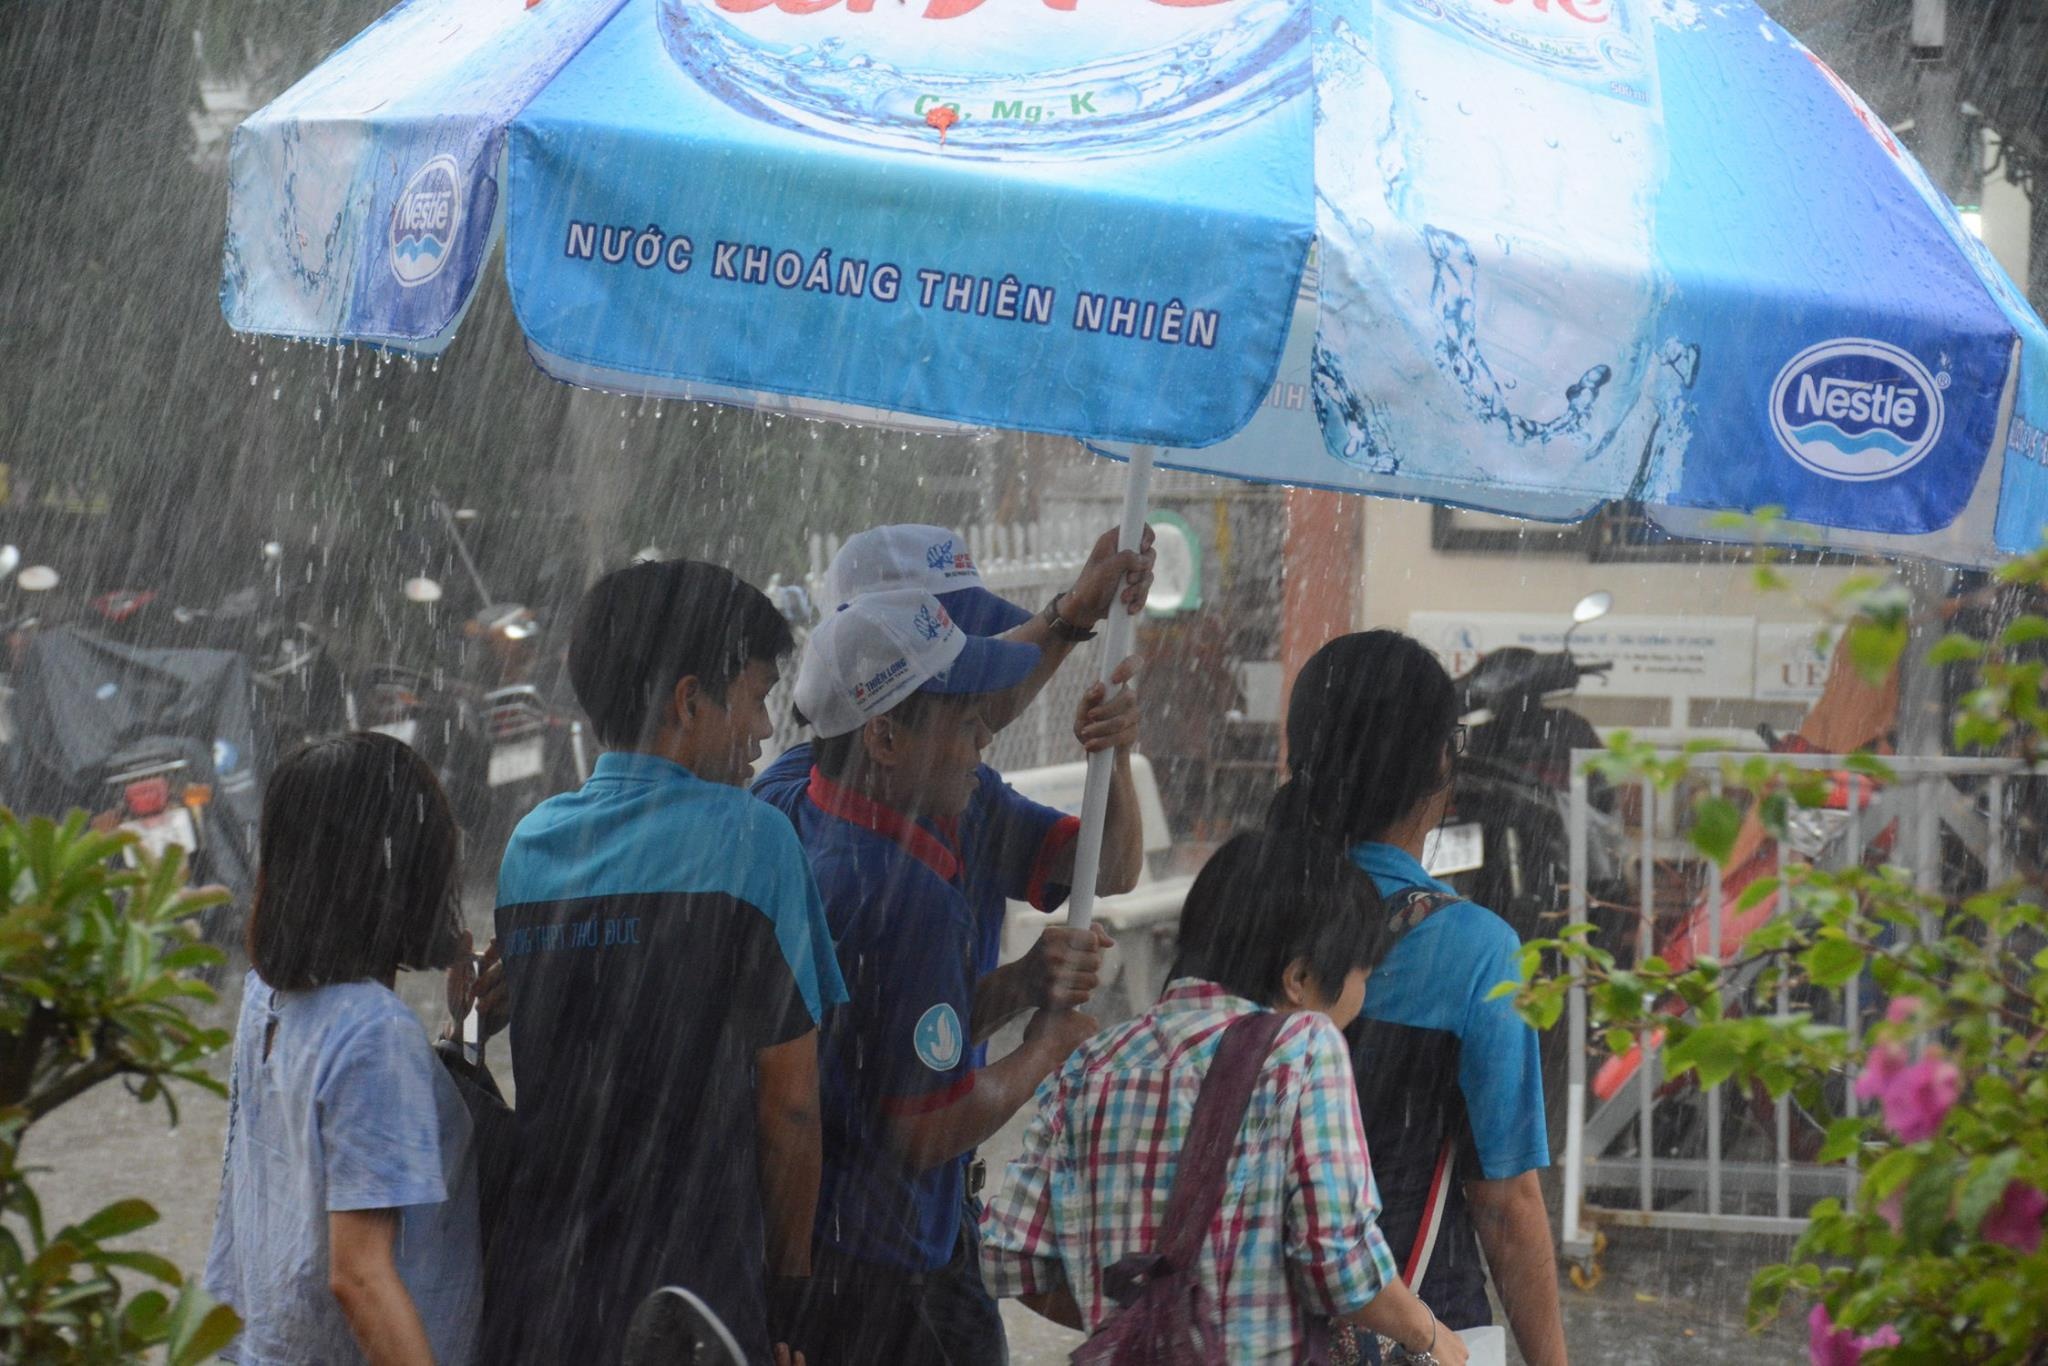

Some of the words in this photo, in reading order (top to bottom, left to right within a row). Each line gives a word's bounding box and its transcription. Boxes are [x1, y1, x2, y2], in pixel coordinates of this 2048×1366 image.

[1069, 91, 1098, 115] K
[565, 221, 693, 272] NƯỚC
[713, 242, 900, 301] KHOÁNG
[919, 270, 1053, 324] THIÊN
[1075, 292, 1219, 348] NHIÊN
